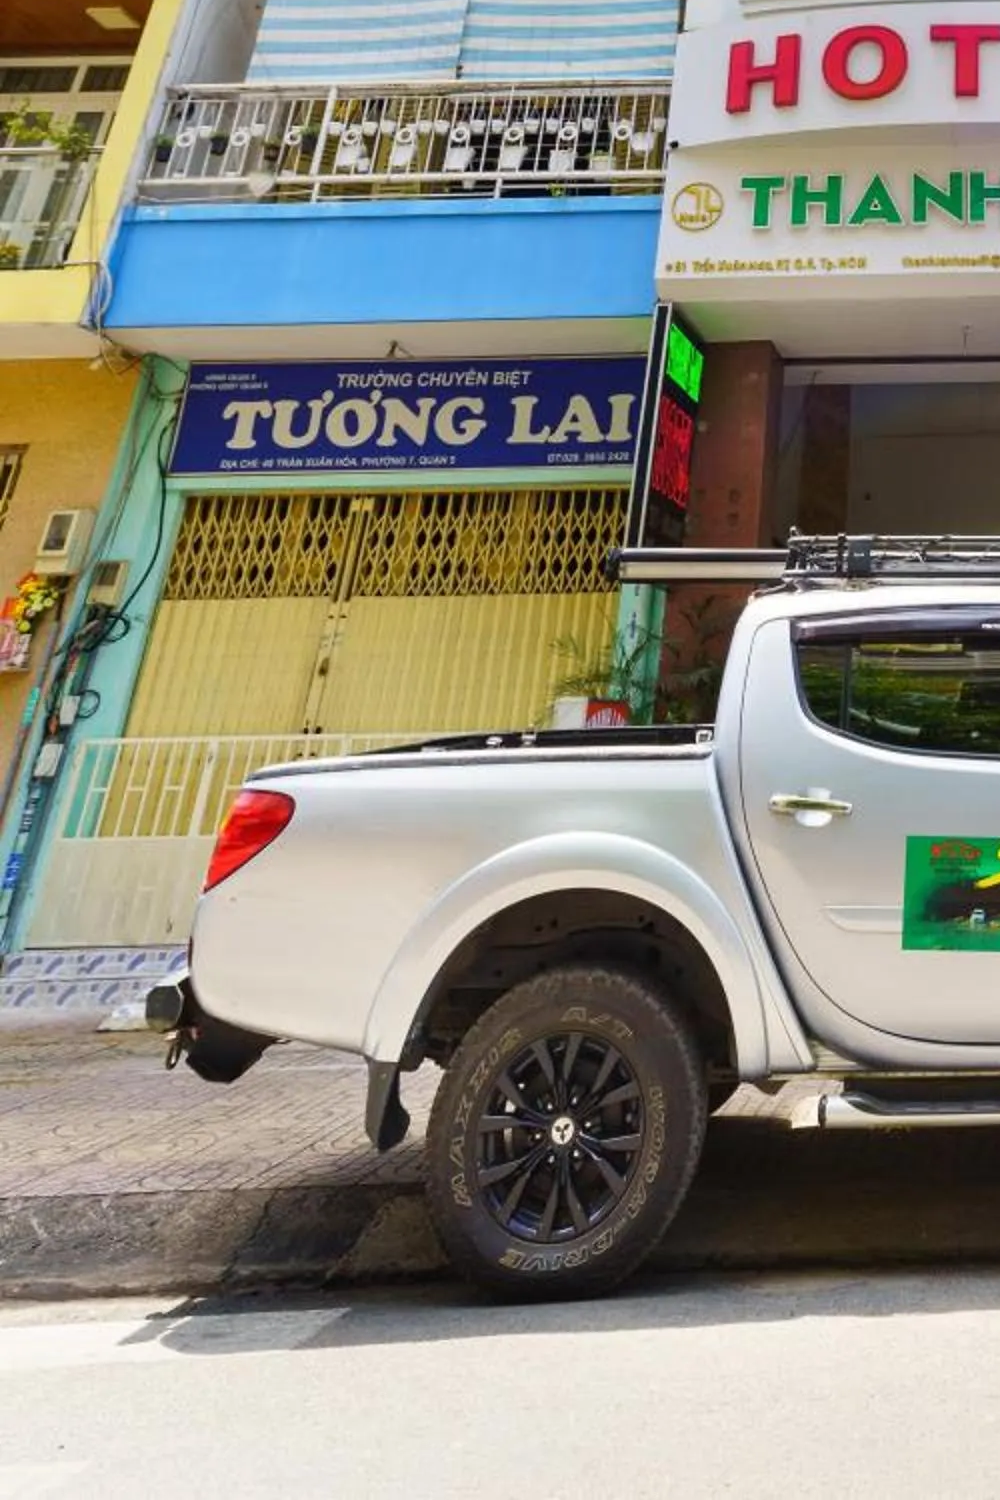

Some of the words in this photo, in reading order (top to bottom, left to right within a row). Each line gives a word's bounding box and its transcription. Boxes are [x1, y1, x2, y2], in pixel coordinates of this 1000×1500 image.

[336, 369, 413, 389] TRƯỜNG
[417, 367, 489, 387] CHUYÊN
[493, 370, 533, 388] BIỆT
[221, 389, 487, 450] TƯƠNG
[506, 393, 637, 445] LAI
